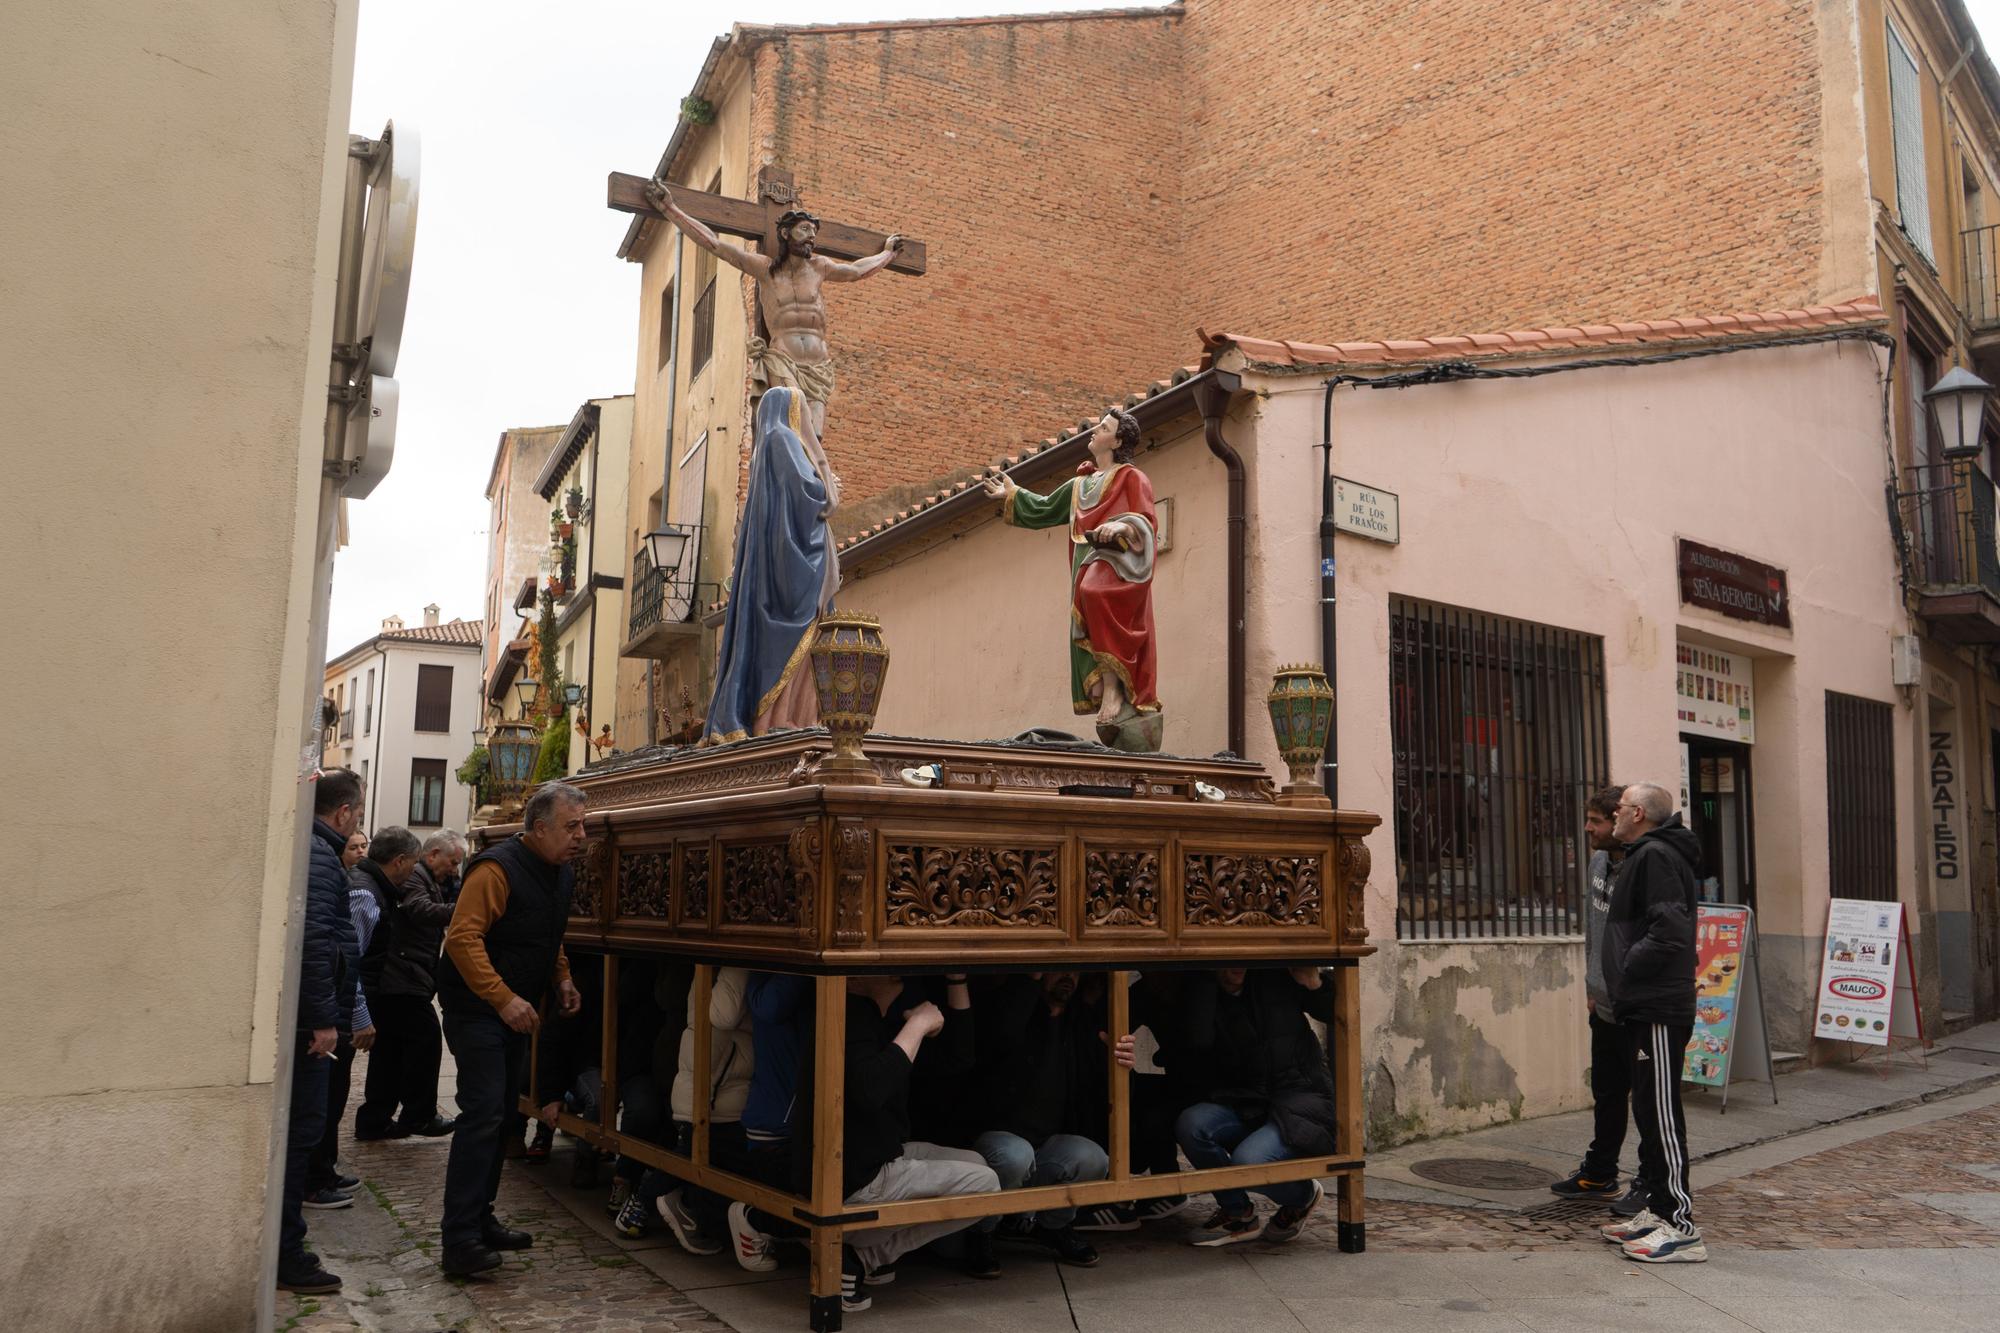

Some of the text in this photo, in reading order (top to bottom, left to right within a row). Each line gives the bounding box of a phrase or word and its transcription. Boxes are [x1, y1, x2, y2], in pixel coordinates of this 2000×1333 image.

[1352, 503, 1385, 520] DE LOS
[1349, 514, 1389, 533] FRANCOS
[1929, 732, 1959, 880] ZAPATERO
[1839, 983, 1877, 995] MAUCO
